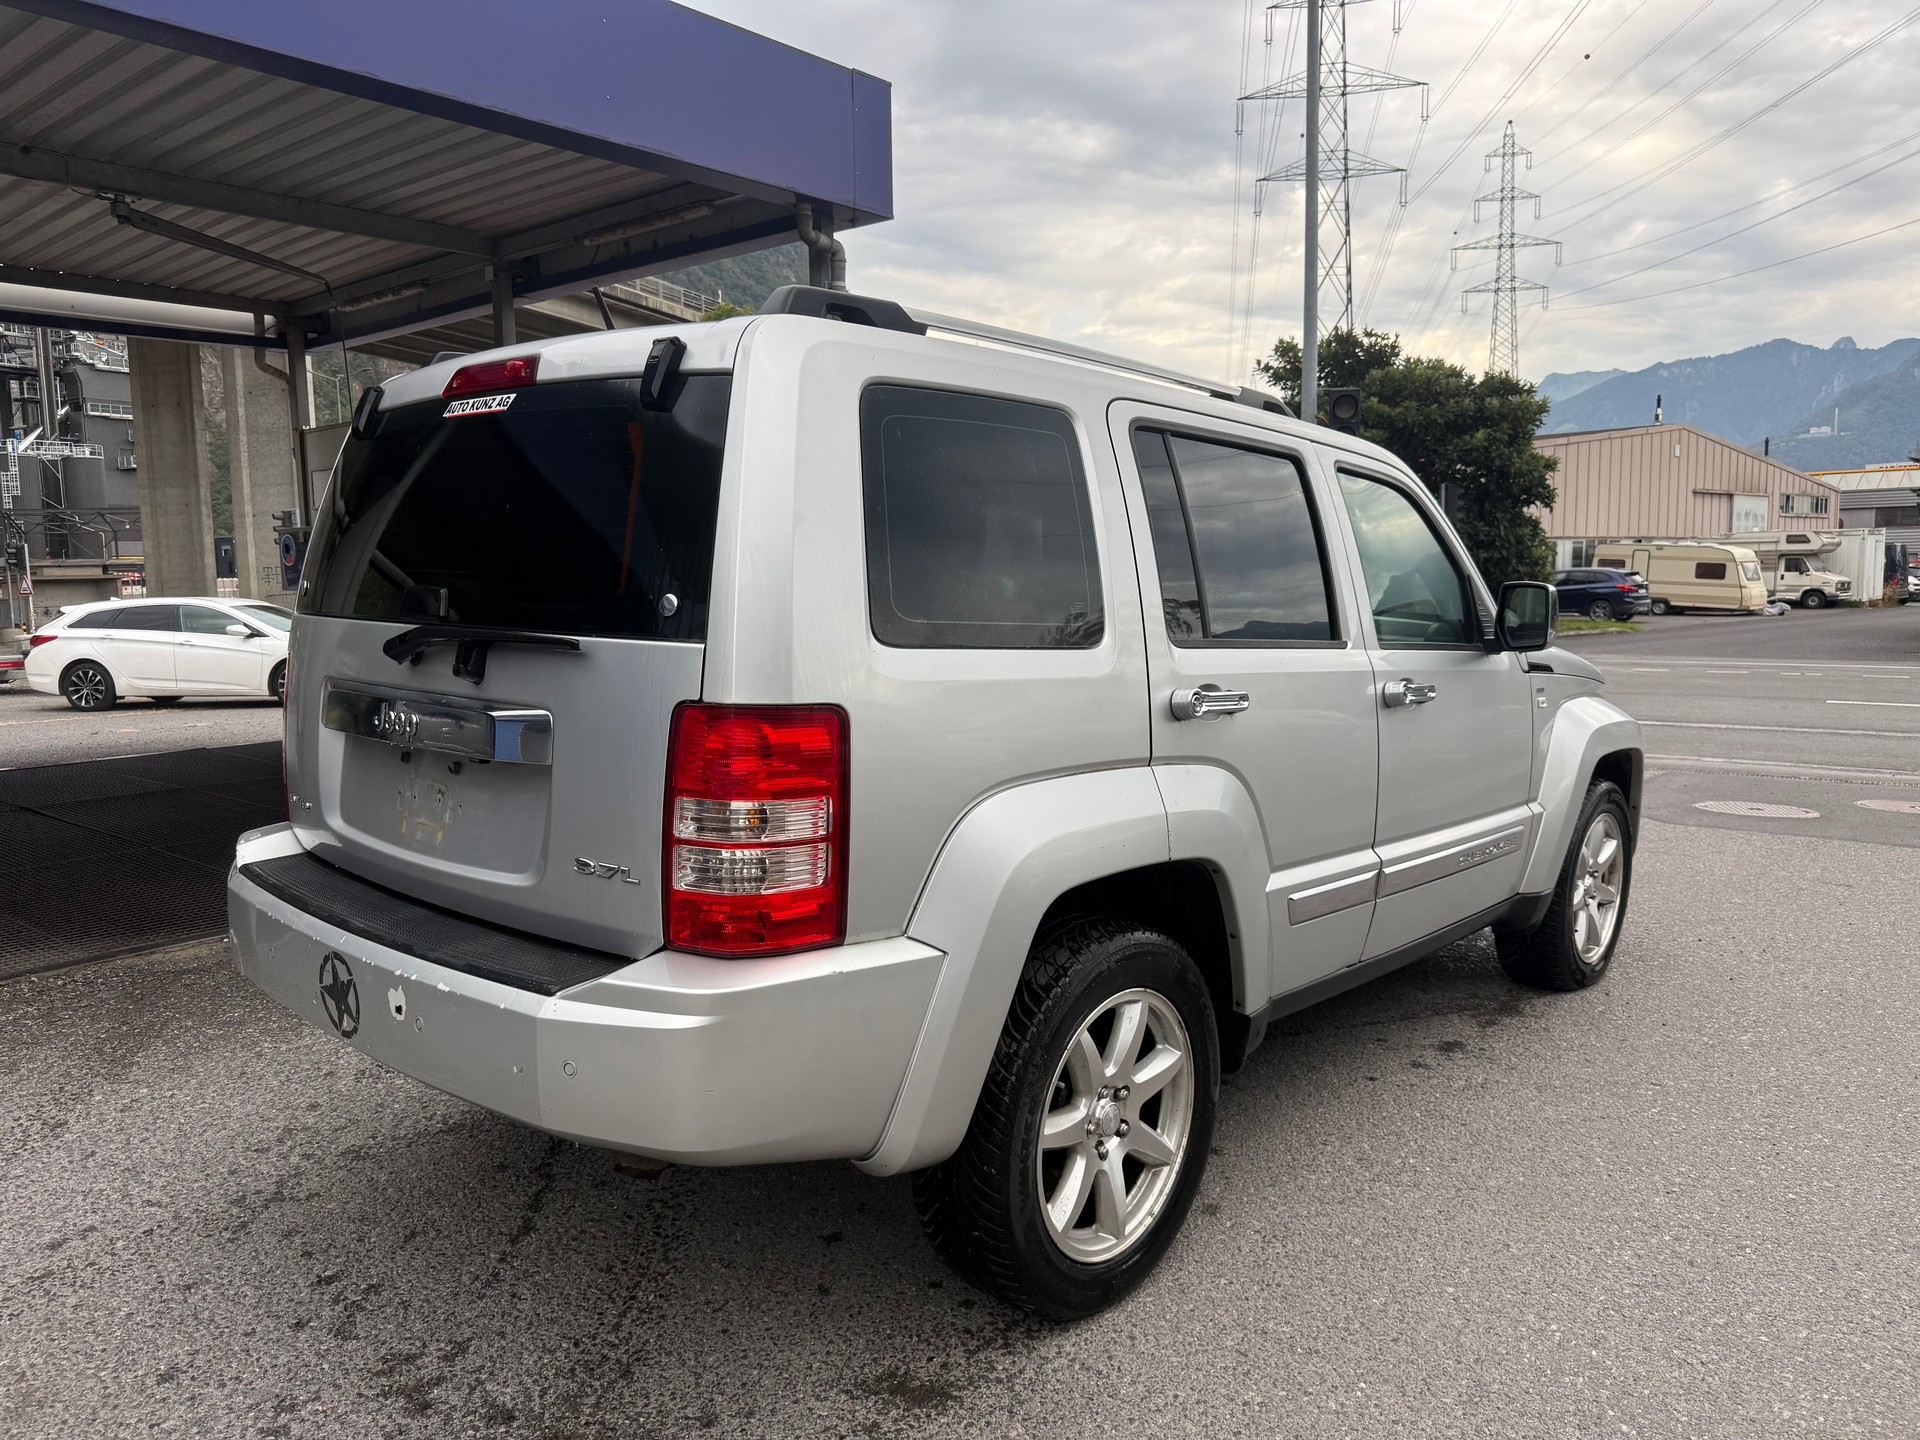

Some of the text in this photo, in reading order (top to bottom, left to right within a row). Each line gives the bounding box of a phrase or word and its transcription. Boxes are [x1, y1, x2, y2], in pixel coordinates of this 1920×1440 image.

[445, 396, 512, 416] AUTO KUNZ AG
[374, 702, 420, 742] Jeep
[573, 857, 641, 885] 3.7L
